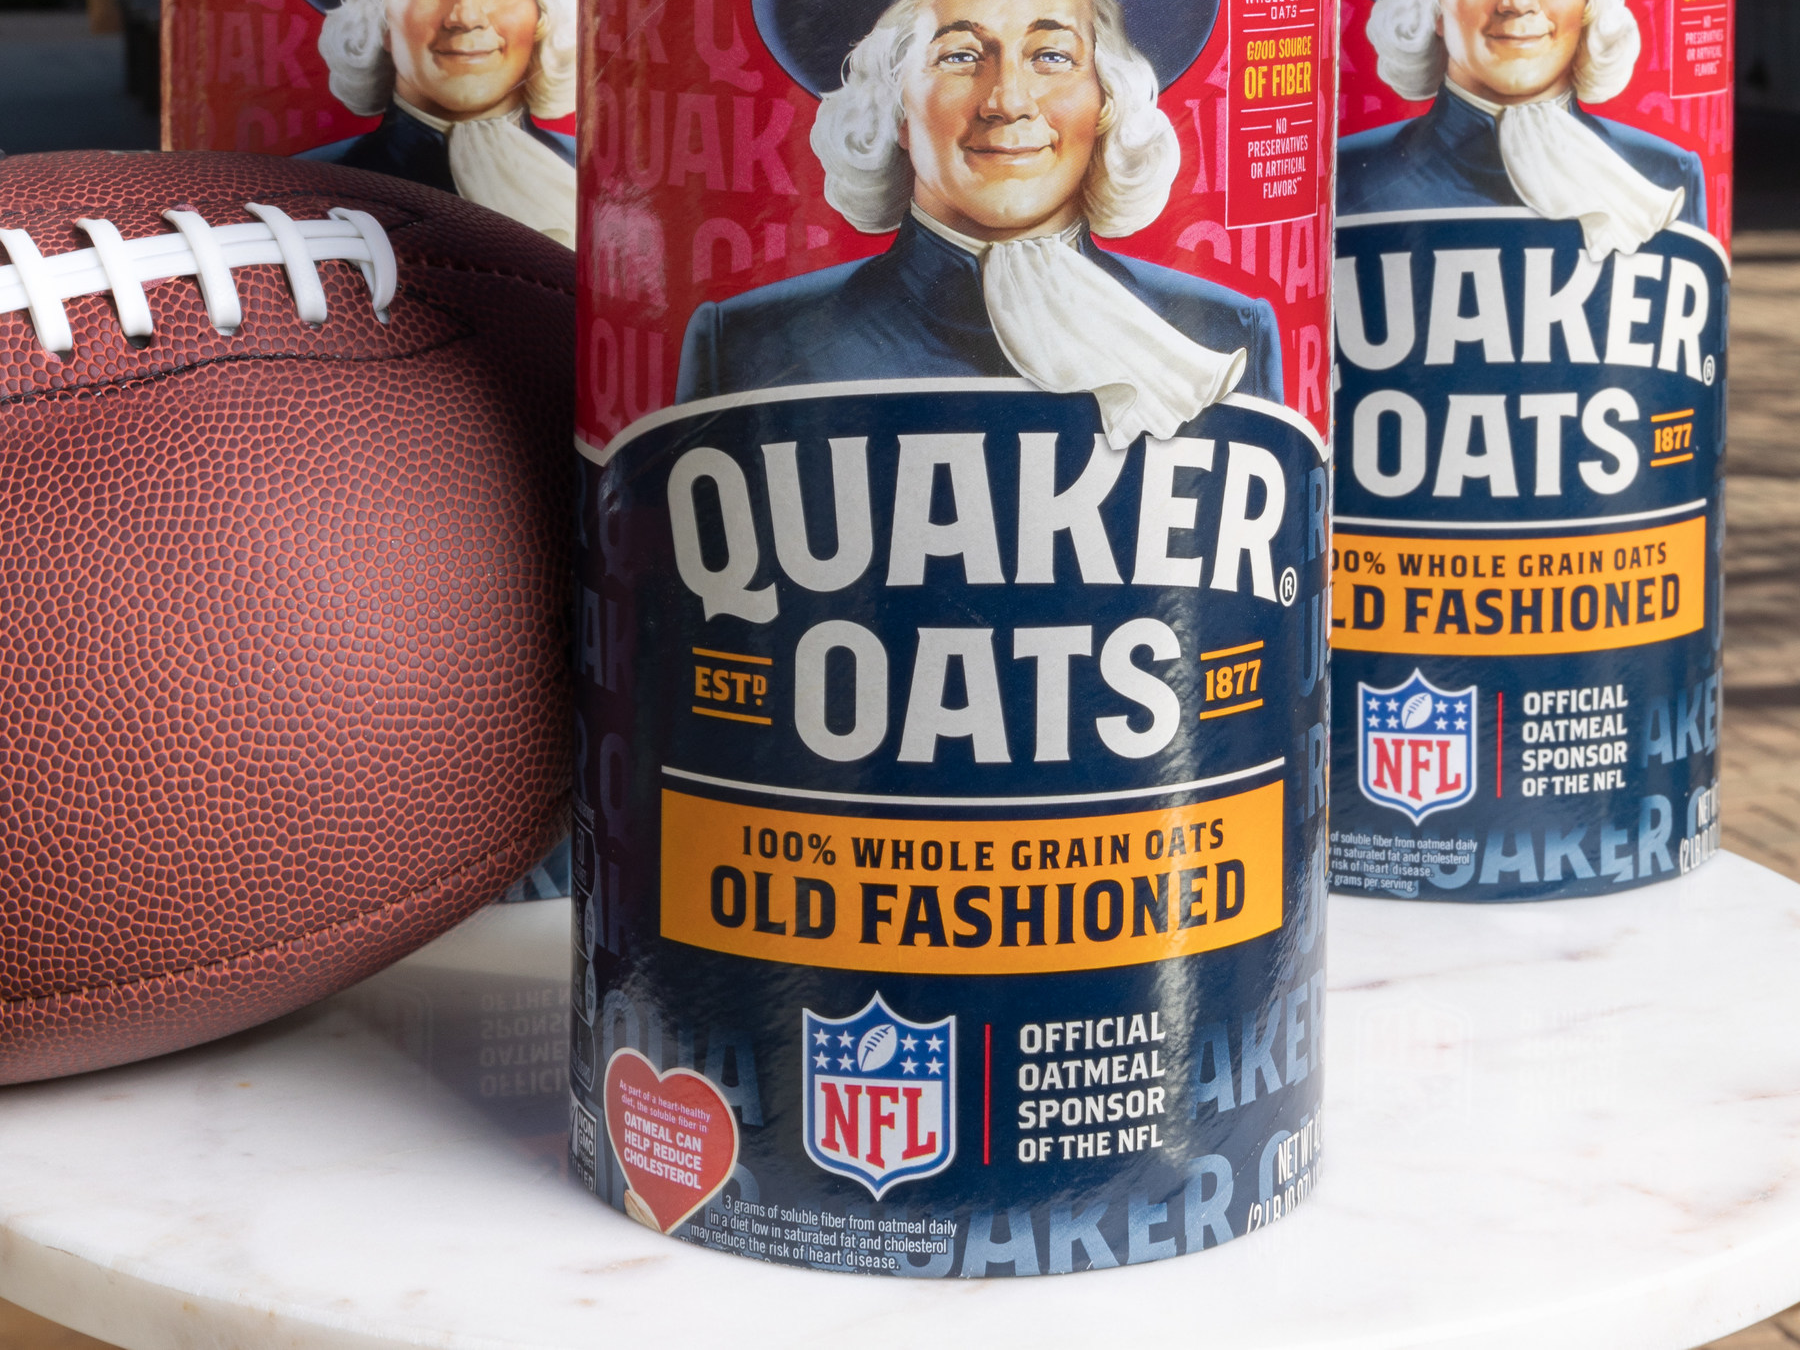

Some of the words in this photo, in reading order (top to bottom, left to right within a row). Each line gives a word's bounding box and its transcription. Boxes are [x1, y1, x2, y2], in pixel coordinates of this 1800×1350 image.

[1270, 5, 1298, 20] OATS
[1246, 39, 1276, 61] GOOD
[1278, 36, 1312, 59] SOURCE
[1244, 65, 1268, 99] OF
[1271, 61, 1312, 97] FIBER
[1247, 134, 1309, 158] PRESERVATIVES
[1275, 117, 1287, 135] NO
[1250, 161, 1263, 179] OR
[1265, 156, 1306, 178] ARTIFICIAL
[1336, 247, 1715, 393] UAKER®
[1352, 387, 1641, 498] OATS
[1653, 422, 1693, 454] 1877
[1398, 551, 1506, 578] WHOLE
[1518, 549, 1603, 578] GRAIN
[1613, 541, 1668, 572] OATS
[1403, 572, 1681, 636] FASHIONED
[794, 618, 1182, 763] OATS
[1204, 658, 1261, 702] 1877
[1523, 684, 1629, 716] OFFICIAL
[1522, 713, 1628, 744] OATMEAL
[1372, 737, 1462, 801] NFL
[1522, 741, 1628, 772] SPONSOR
[1522, 777, 1548, 797] OF
[1551, 773, 1590, 796] THE
[1593, 769, 1626, 792] NFL
[741, 823, 838, 866] 100%
[850, 835, 995, 872] WHOLE
[1011, 832, 1132, 872] GRAIN
[1145, 818, 1225, 859] OATS
[1421, 851, 1470, 865] cholesterol
[709, 863, 838, 941] OLD
[858, 858, 1247, 949] FASHIONED
[1019, 1011, 1166, 1055] OFFICIAL
[1018, 1050, 1166, 1092] OATMEAL
[619, 1079, 628, 1091] As
[628, 1084, 641, 1099] part
[642, 1089, 650, 1101] of
[651, 1096, 657, 1105] a
[658, 1094, 711, 1123] heart-healthy
[621, 1093, 636, 1110] diet,
[636, 1100, 649, 1113] the
[649, 1102, 676, 1124] soluble
[678, 1114, 697, 1130] fiber
[699, 1122, 708, 1133] in
[1018, 1086, 1165, 1130] SPONSOR
[624, 1111, 673, 1143] OATMEAL
[676, 1131, 702, 1153] CAN
[820, 1082, 937, 1170] NFL
[1018, 1136, 1054, 1163] OF
[1056, 1131, 1112, 1160] THE
[1118, 1123, 1163, 1153] NFL
[624, 1128, 651, 1151] HELP
[653, 1145, 702, 1171] REDUCE
[624, 1148, 702, 1190] CHOLESTEROL
[1278, 1132, 1300, 1185] NET
[710, 1208, 719, 1225] in
[721, 1216, 728, 1227] a
[730, 1214, 750, 1233] diet
[751, 1218, 769, 1236] low
[771, 1222, 781, 1239] in
[784, 1224, 837, 1246] saturated
[839, 1229, 857, 1248] fat
[858, 1232, 882, 1250] and
[884, 1234, 947, 1254] cholesterol
[725, 1194, 732, 1209] 3
[733, 1199, 765, 1218] grams
[767, 1204, 779, 1219] of
[780, 1205, 818, 1227] soluble
[820, 1211, 846, 1229] fiber
[849, 1214, 875, 1232] from
[878, 1217, 925, 1234] oatmeal
[928, 1219, 957, 1238] daily
[690, 1224, 710, 1244] may
[711, 1229, 746, 1249] reduce
[748, 1236, 767, 1254] the
[769, 1240, 790, 1258] risk
[792, 1244, 805, 1261] of
[808, 1245, 842, 1265] heart
[846, 1250, 900, 1269] disease.
